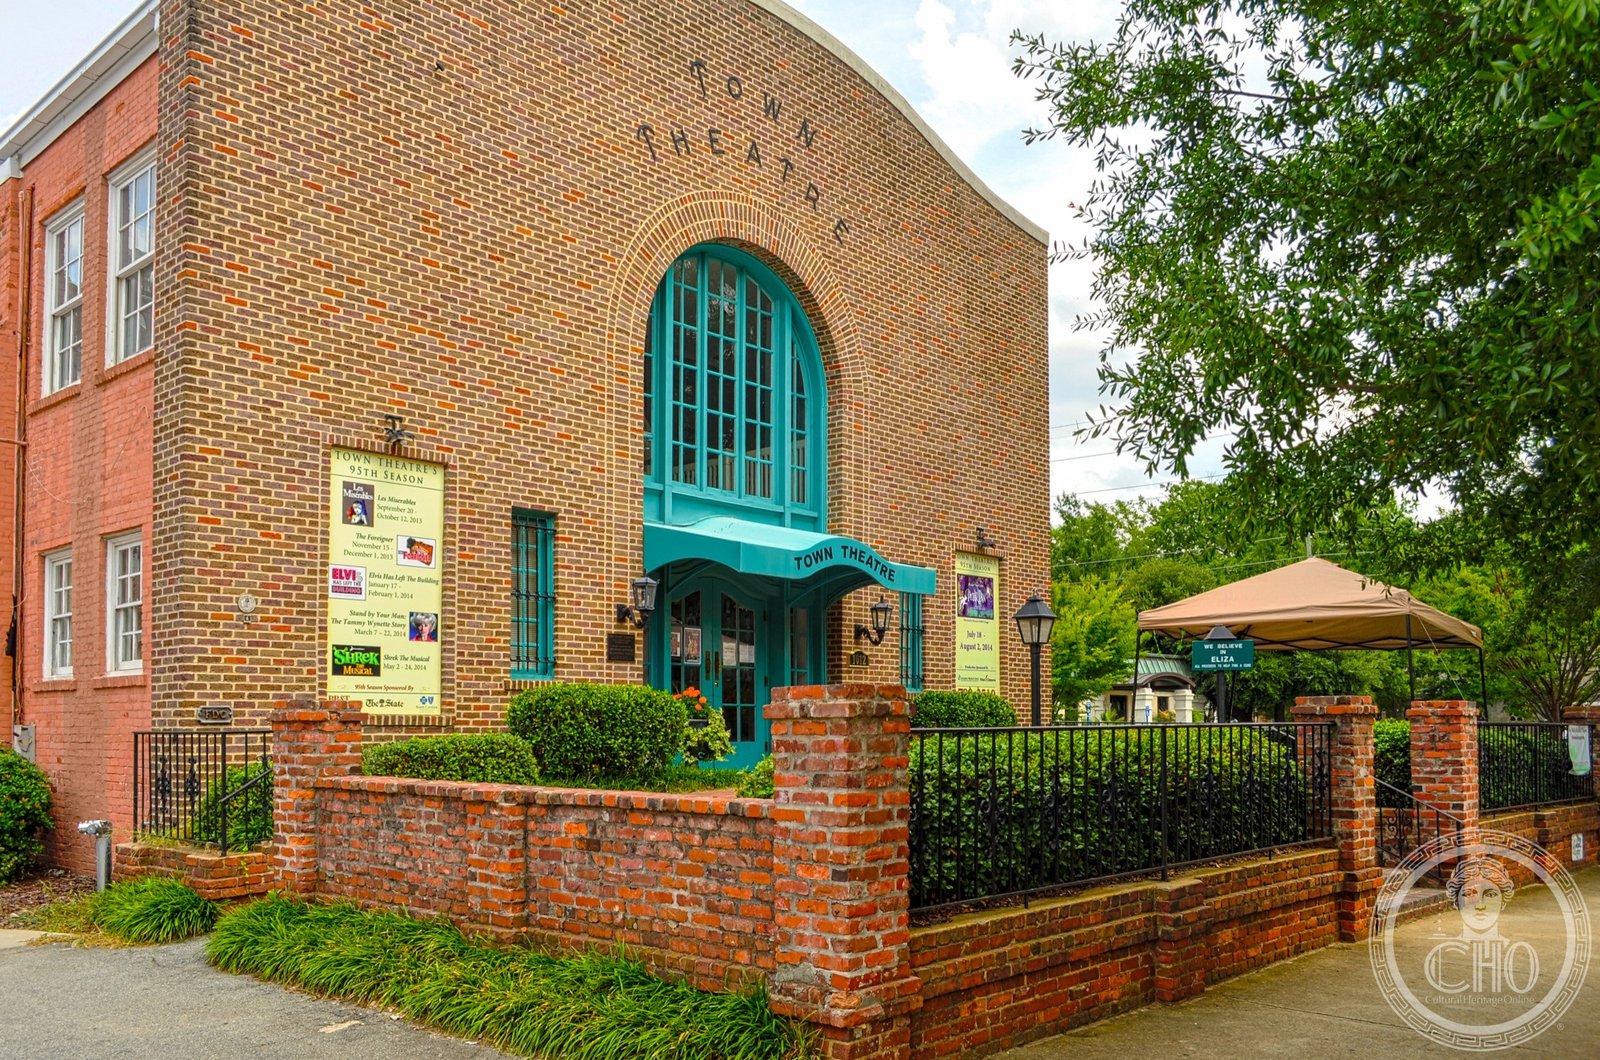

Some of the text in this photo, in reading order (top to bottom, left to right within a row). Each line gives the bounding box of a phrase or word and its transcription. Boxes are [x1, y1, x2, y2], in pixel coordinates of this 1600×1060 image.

[690, 60, 817, 148] TOWN
[637, 124, 849, 244] THEATRE
[335, 450, 438, 475] TOWN THEATRE'S
[350, 465, 378, 478] 95TH
[353, 483, 364, 491] Les
[377, 504, 406, 514] September
[377, 513, 399, 521] October
[367, 534, 393, 543] Foreigner
[352, 541, 382, 550] November
[344, 550, 373, 559] December
[794, 546, 895, 582] TOWN THEATRE
[332, 568, 363, 582] ELVIS
[395, 574, 406, 582] Left
[417, 576, 439, 586] Building
[369, 581, 391, 589] January
[368, 590, 392, 599] February
[368, 611, 375, 619] by
[367, 620, 390, 628] Wynette
[391, 621, 406, 629] Story
[354, 628, 372, 636] March
[967, 630, 976, 639] July
[960, 642, 976, 652] August
[366, 699, 404, 707] The State
[205, 710, 227, 719] FDC
